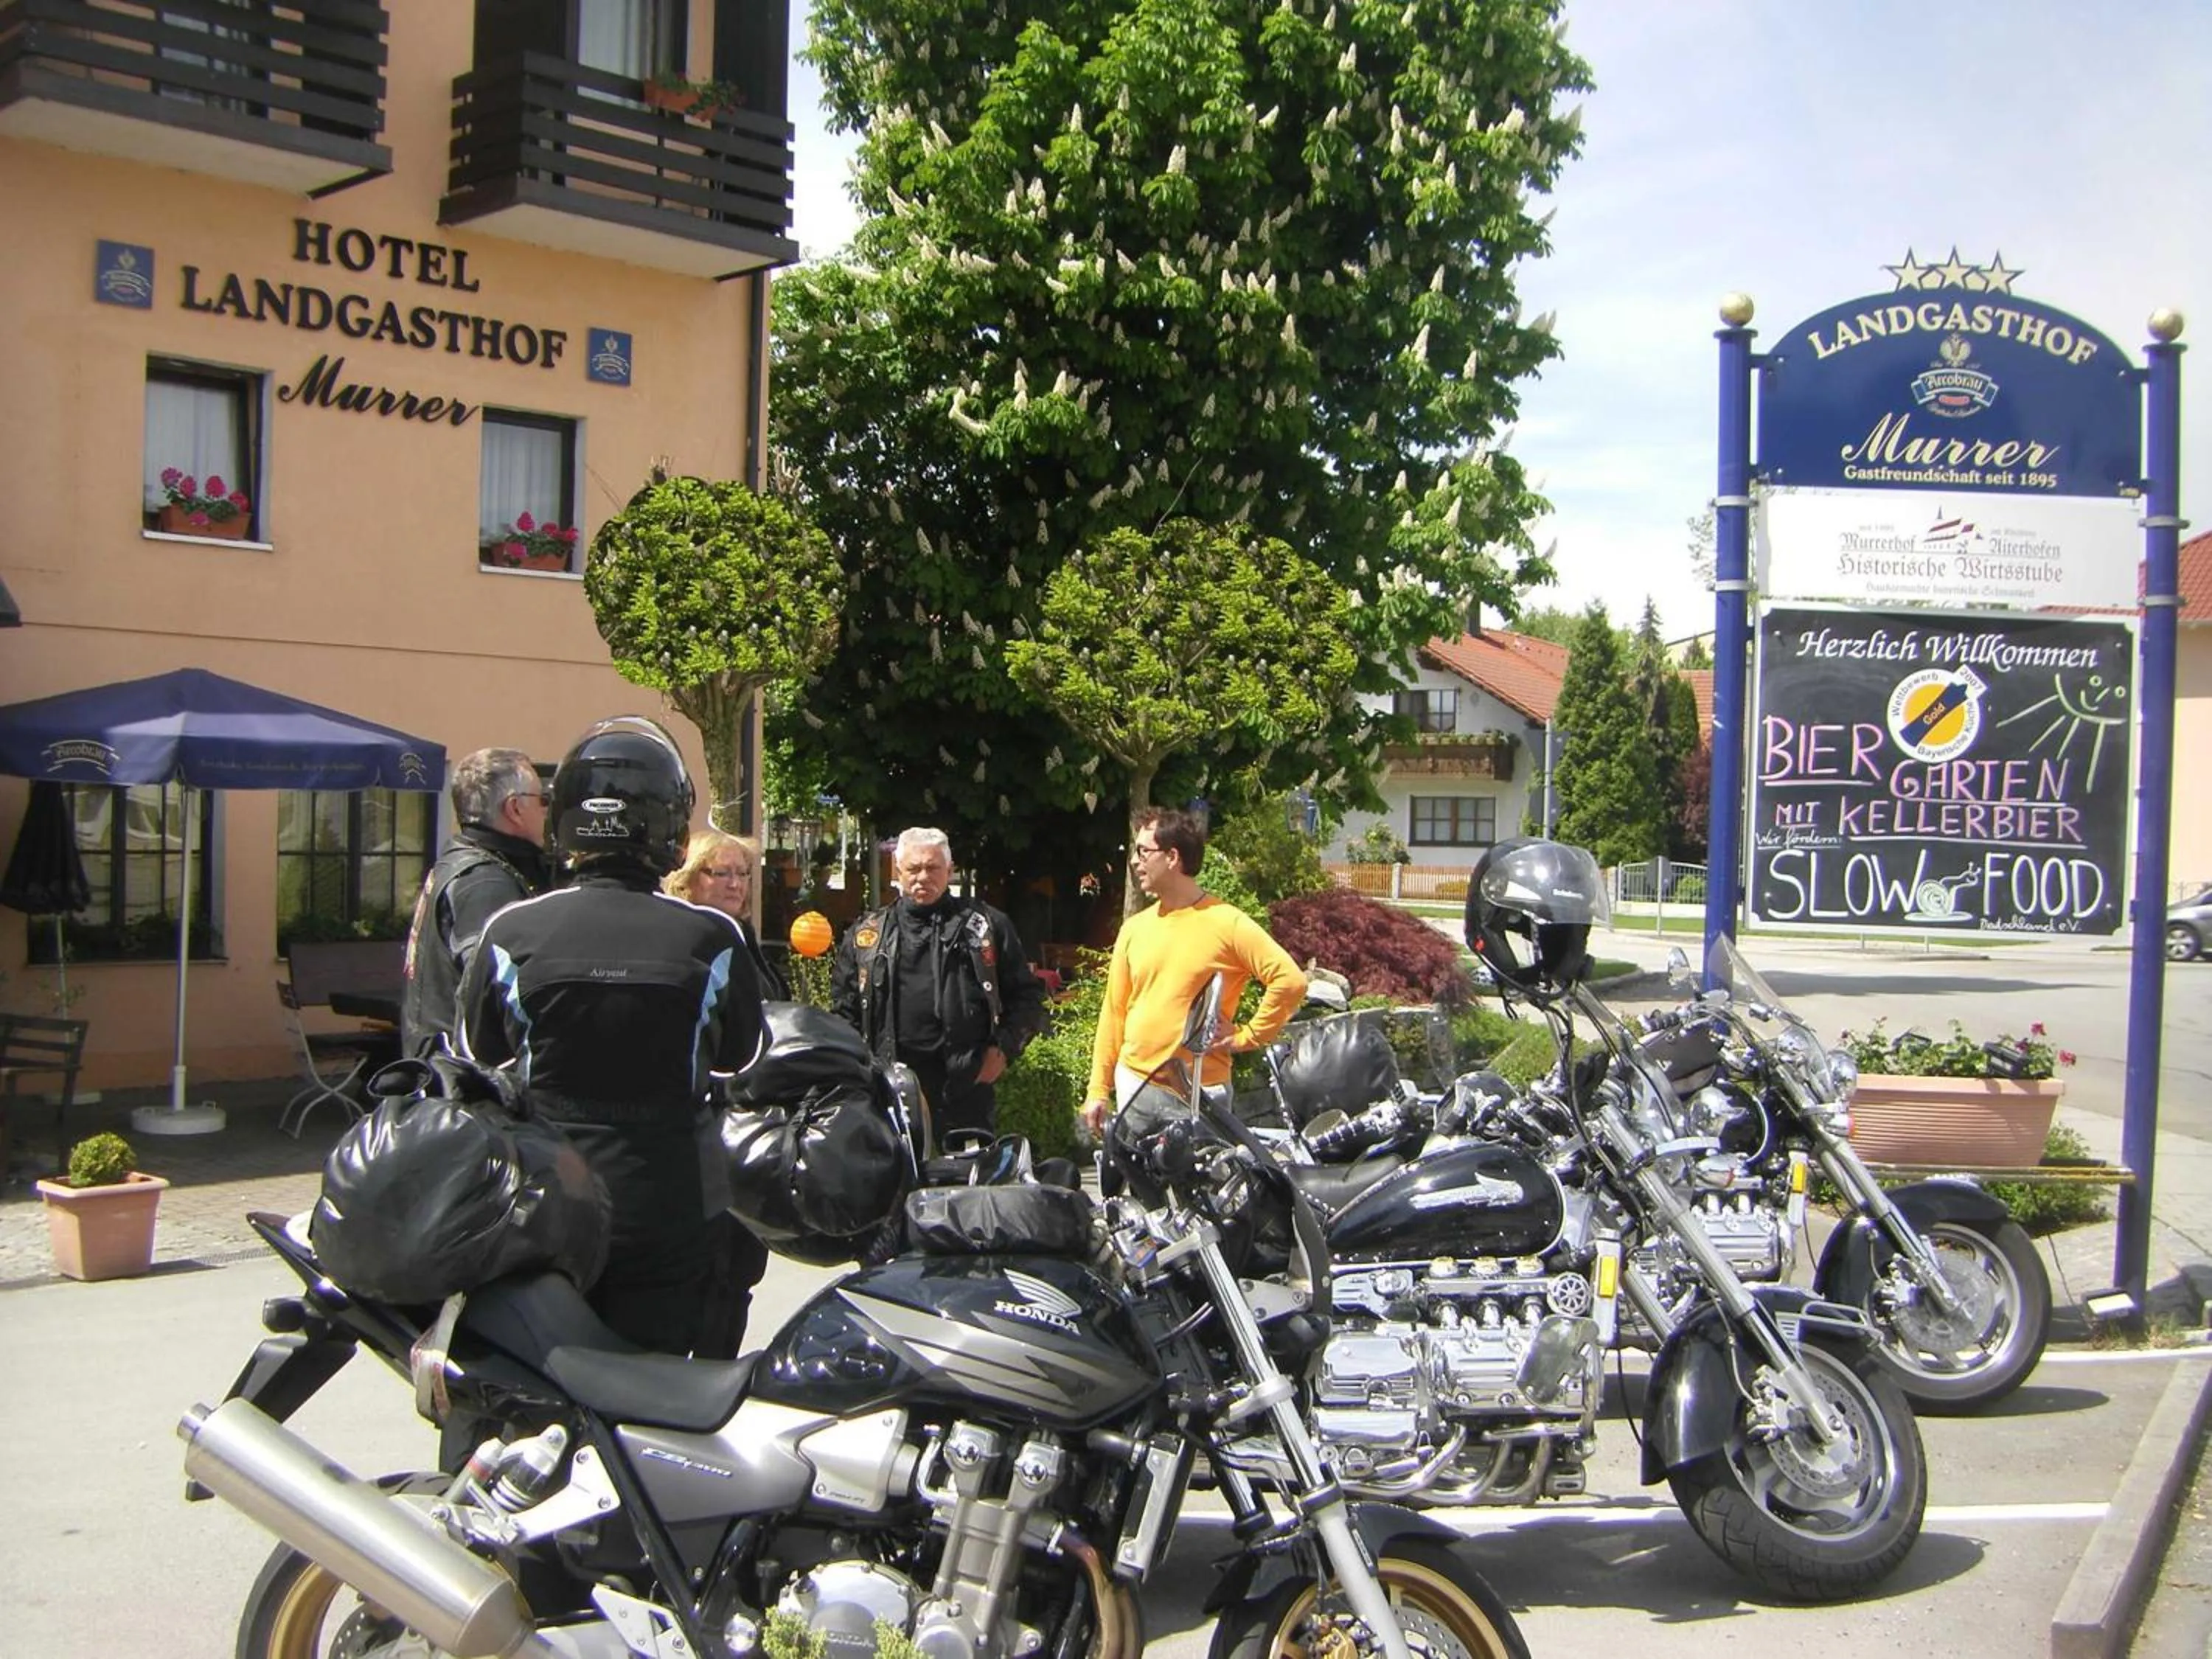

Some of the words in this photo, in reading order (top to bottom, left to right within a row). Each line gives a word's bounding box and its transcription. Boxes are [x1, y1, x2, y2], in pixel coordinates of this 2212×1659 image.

[293, 219, 480, 293] HOTEL
[181, 265, 568, 368] LANDGASTHOF
[1809, 302, 2097, 364] LANDGASTHOF
[277, 355, 482, 426] Murrer
[1840, 411, 2061, 469] Murrer
[1844, 465, 1981, 485] Gastfreundschaft
[1985, 470, 2014, 486] seit
[2020, 473, 2058, 488] 1895
[1840, 532, 1917, 552] Murrerhof
[1836, 553, 1948, 579] Historische
[1954, 557, 2065, 583] Wirtsstube
[1795, 627, 1918, 661] Herzlich
[1924, 633, 2100, 673] Willkommen
[1921, 701, 1947, 726] Gold
[1759, 714, 1885, 781] BIER
[1889, 757, 2070, 801] GARTEN
[1755, 827, 1781, 846] Wir
[1775, 801, 1820, 827] MIT
[1838, 796, 2084, 843] KELLERBIER
[1767, 849, 1927, 919] SLOW
[1983, 852, 2105, 919] FOOD
[993, 1299, 1082, 1337] HONDA
